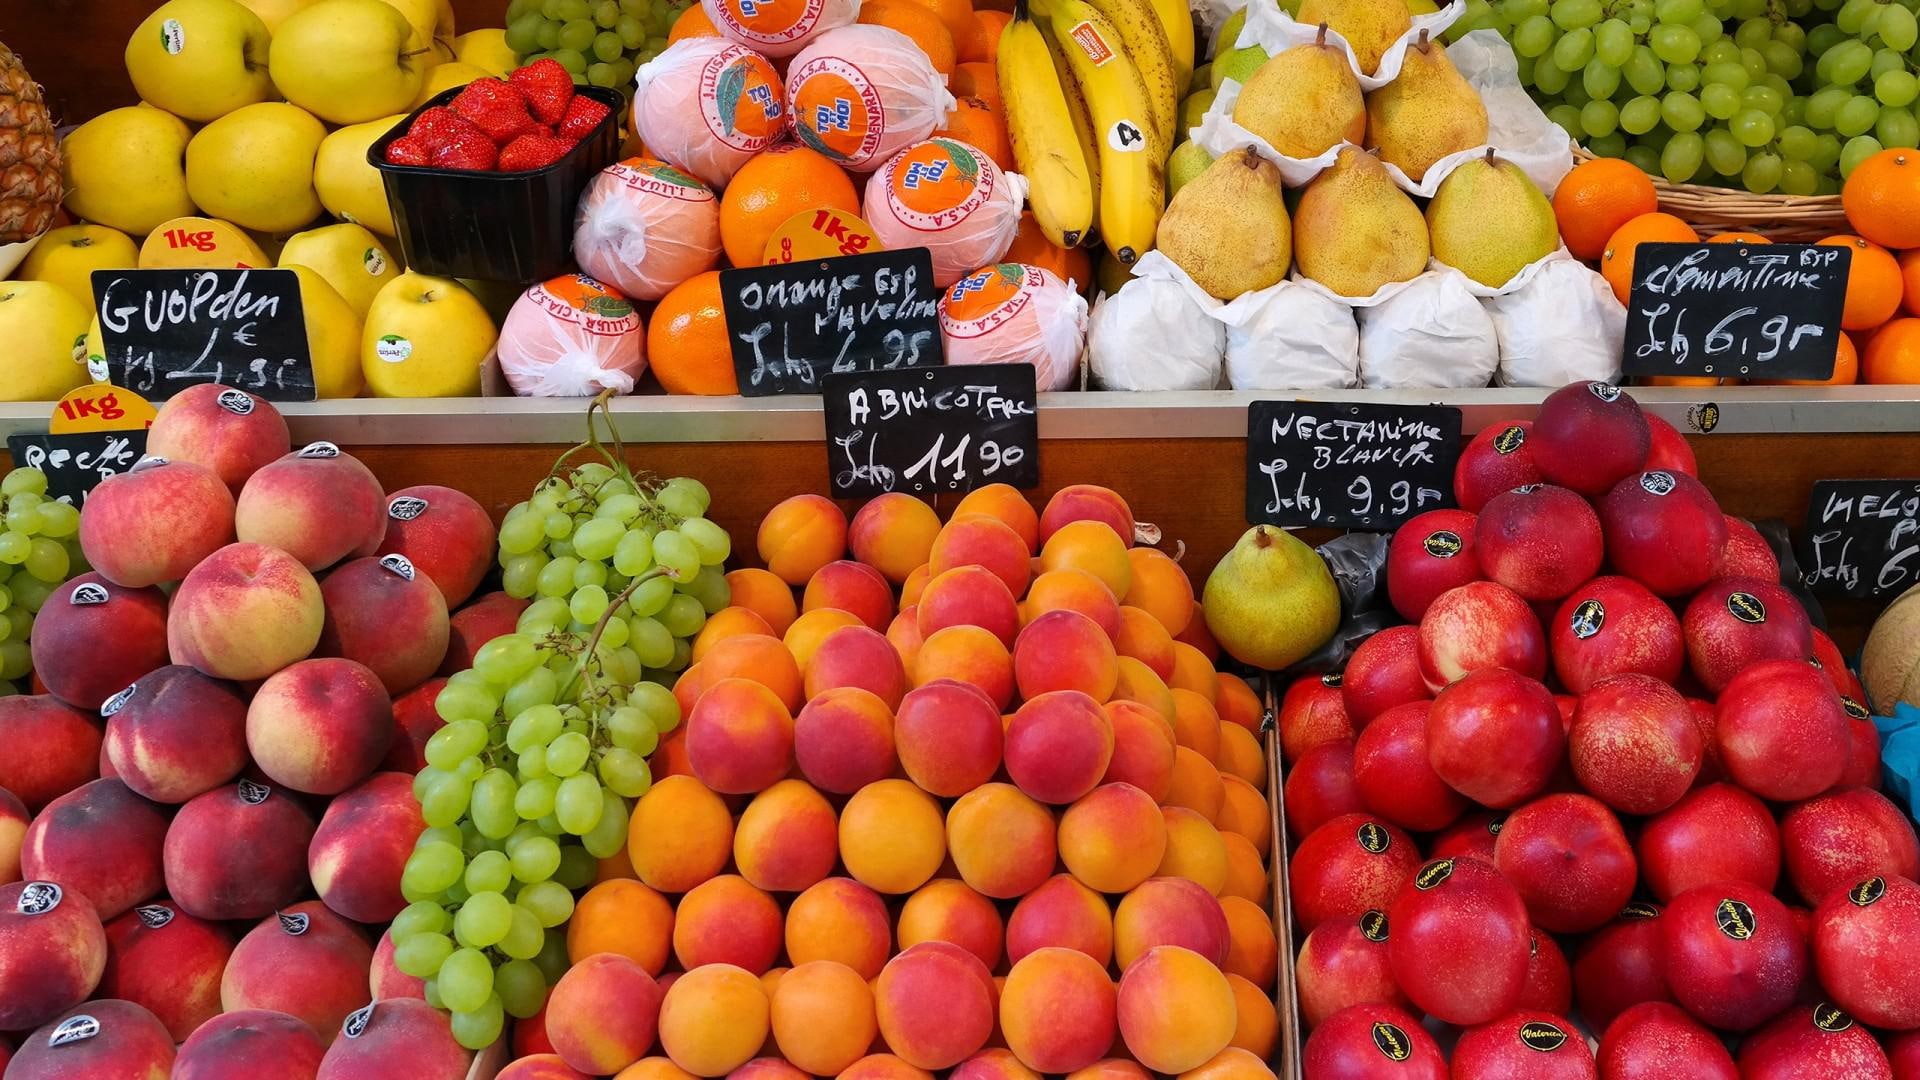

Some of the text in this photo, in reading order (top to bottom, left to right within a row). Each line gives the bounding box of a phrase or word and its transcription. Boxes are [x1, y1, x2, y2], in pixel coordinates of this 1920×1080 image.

[747, 84, 771, 102] TOI
[817, 106, 830, 132] TOI
[836, 98, 850, 130] MOI
[1117, 122, 1142, 146] 4
[904, 162, 923, 188] MOI
[926, 160, 948, 182] TOI
[163, 229, 217, 252] 1kg
[812, 209, 870, 255] 1kg
[970, 272, 993, 291] TOI
[58, 392, 125, 420] 1kg
